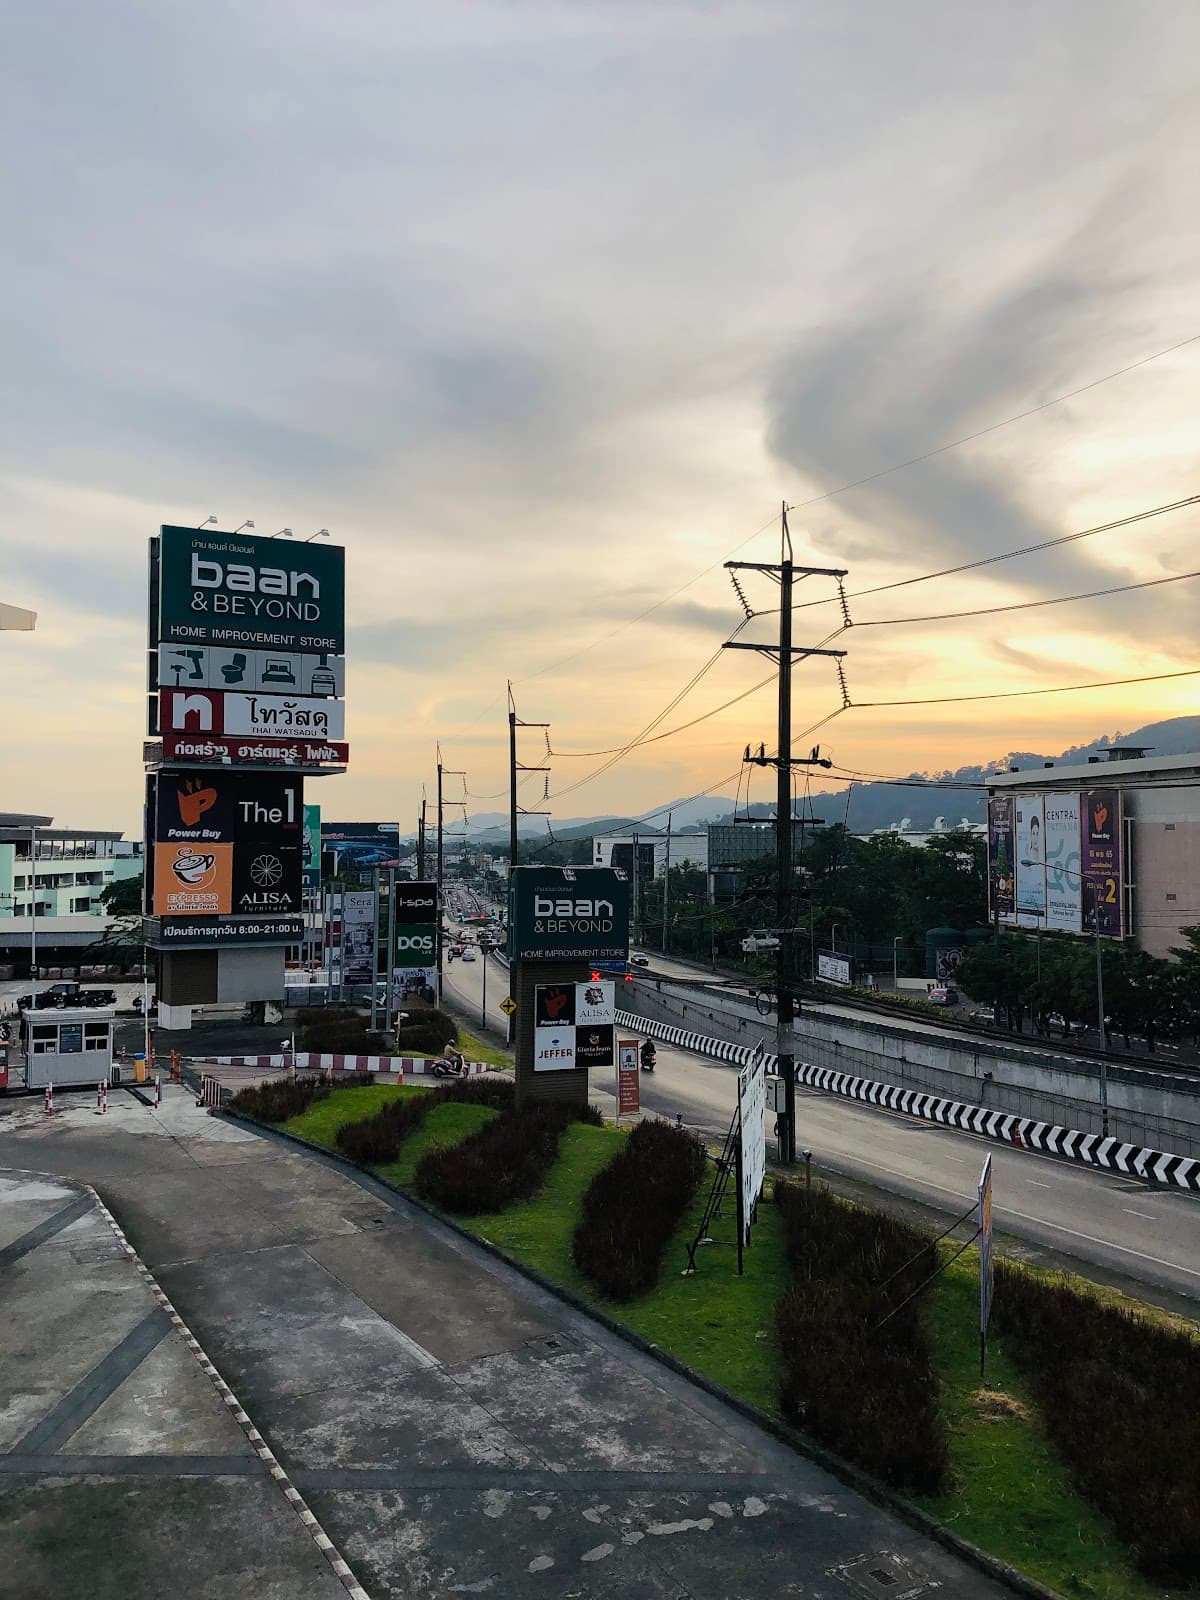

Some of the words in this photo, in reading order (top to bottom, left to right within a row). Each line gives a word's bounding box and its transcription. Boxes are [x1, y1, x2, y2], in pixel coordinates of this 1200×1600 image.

[191, 552, 320, 599] baan
[191, 591, 208, 612] &
[213, 594, 321, 622] BEYOND
[170, 625, 207, 638] HOME
[212, 628, 296, 645] IMPROVEMENT
[300, 636, 336, 649] STORE
[245, 696, 328, 736] ไทวัสดุ
[251, 727, 272, 735] THAI
[275, 728, 317, 736] WATSADU
[175, 741, 229, 757] ก่อสร้าง
[1046, 810, 1078, 821] CENTRAL
[168, 829, 201, 838] Power
[202, 829, 221, 840] Buy
[239, 892, 293, 904] ALISA
[1105, 879, 1116, 903] 2
[399, 895, 434, 908] i-spa
[534, 894, 614, 917] baan
[164, 925, 237, 938] เปิดบริการทุกวัน
[238, 924, 291, 935] 8:00-21:00
[292, 924, 302, 933] น.
[534, 920, 545, 933] &
[547, 919, 613, 933] BEYOND
[397, 936, 433, 950] DOS
[520, 949, 543, 958] HOME
[544, 948, 599, 958] IMPROVEMENT
[600, 948, 625, 957] STORE
[580, 1008, 610, 1018] ALISA
[538, 1048, 573, 1059] JEFFER
